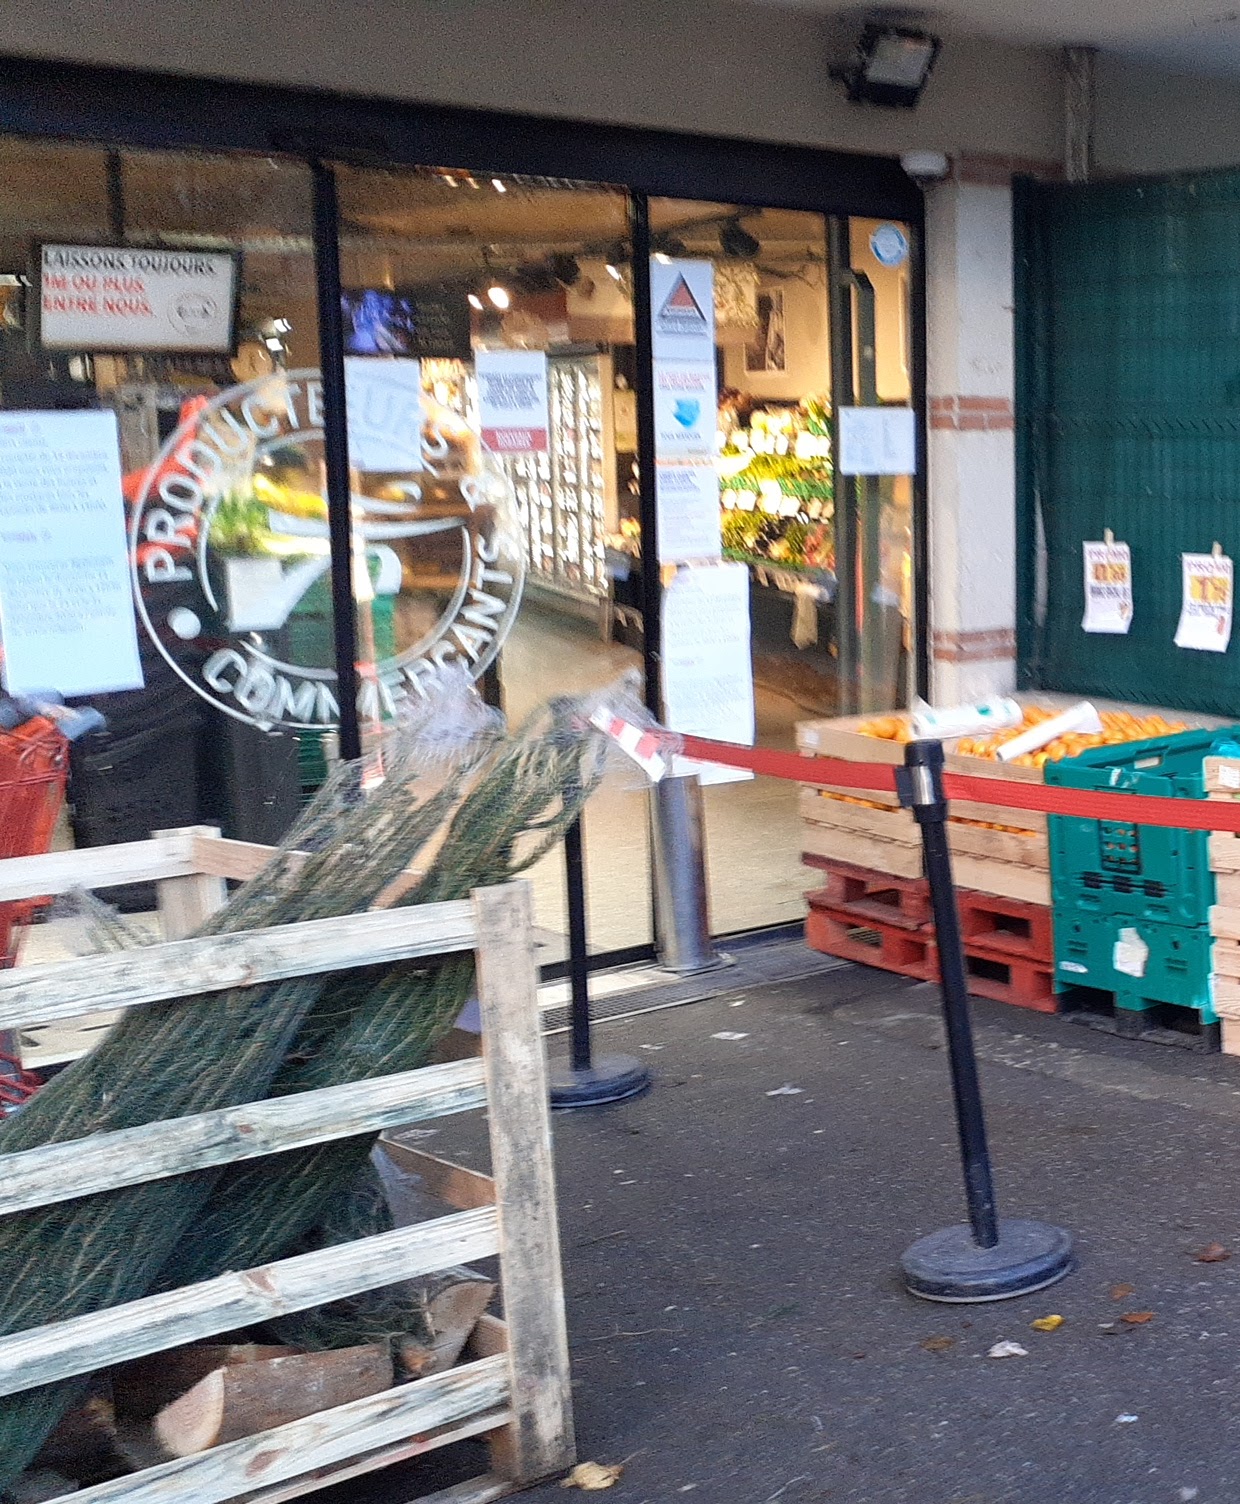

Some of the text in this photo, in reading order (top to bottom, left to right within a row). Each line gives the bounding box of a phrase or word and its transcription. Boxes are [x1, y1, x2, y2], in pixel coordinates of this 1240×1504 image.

[44, 250, 216, 275] LAISSONS TOUJOURS
[102, 275, 146, 294] PLUS
[43, 295, 97, 313] ENTRE
